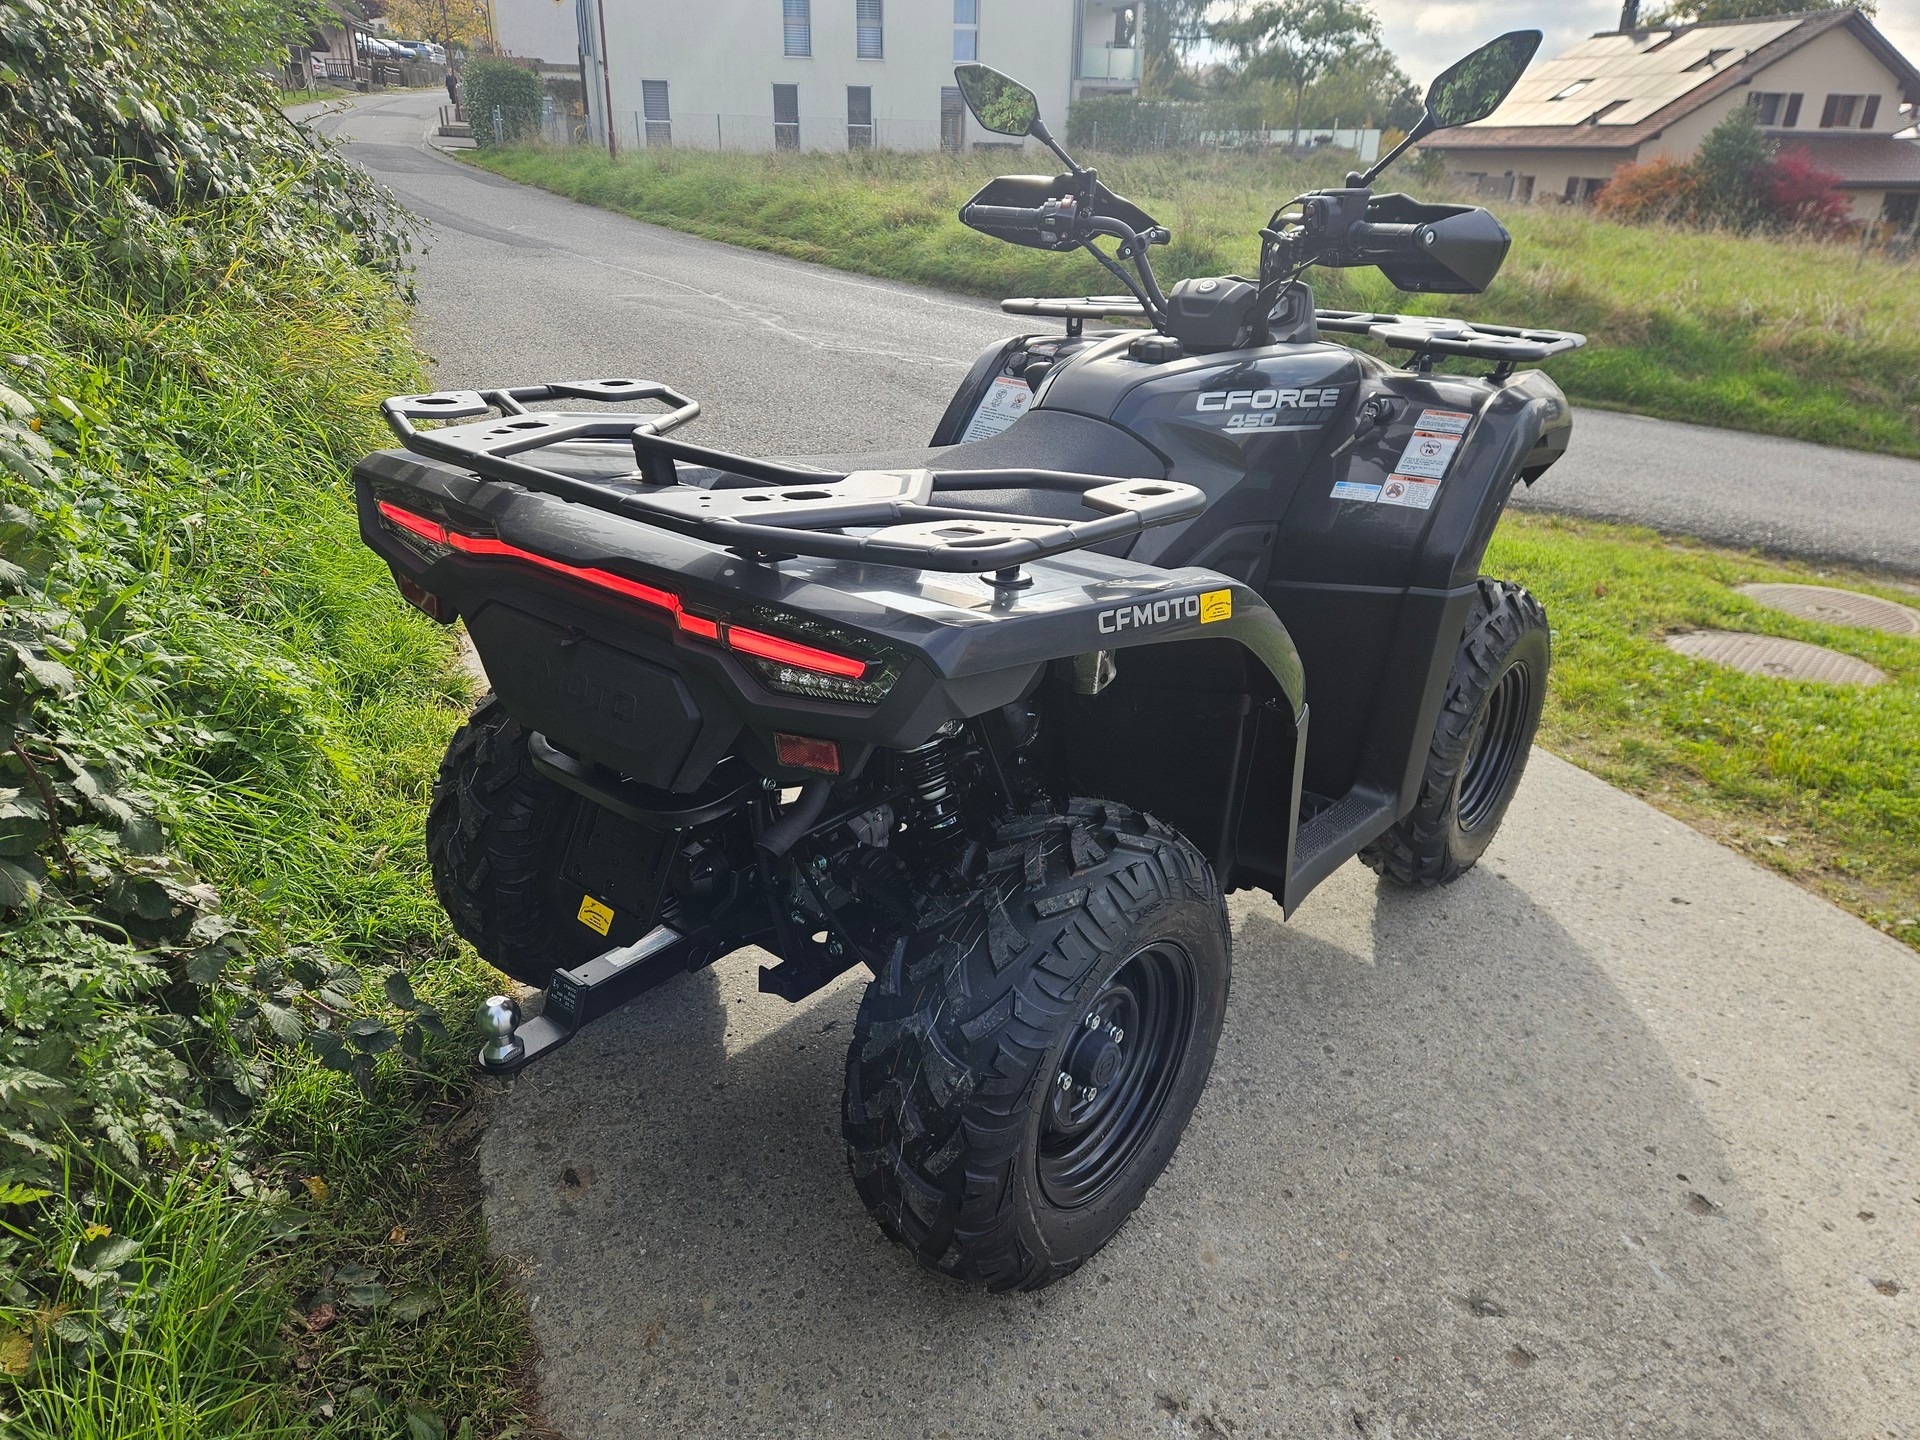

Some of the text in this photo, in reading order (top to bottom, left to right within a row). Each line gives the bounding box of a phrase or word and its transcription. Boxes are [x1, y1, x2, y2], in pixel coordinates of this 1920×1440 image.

[1196, 388, 1340, 411] CFORCE
[1226, 412, 1278, 428] 450
[1098, 595, 1200, 634] CFMOTO
